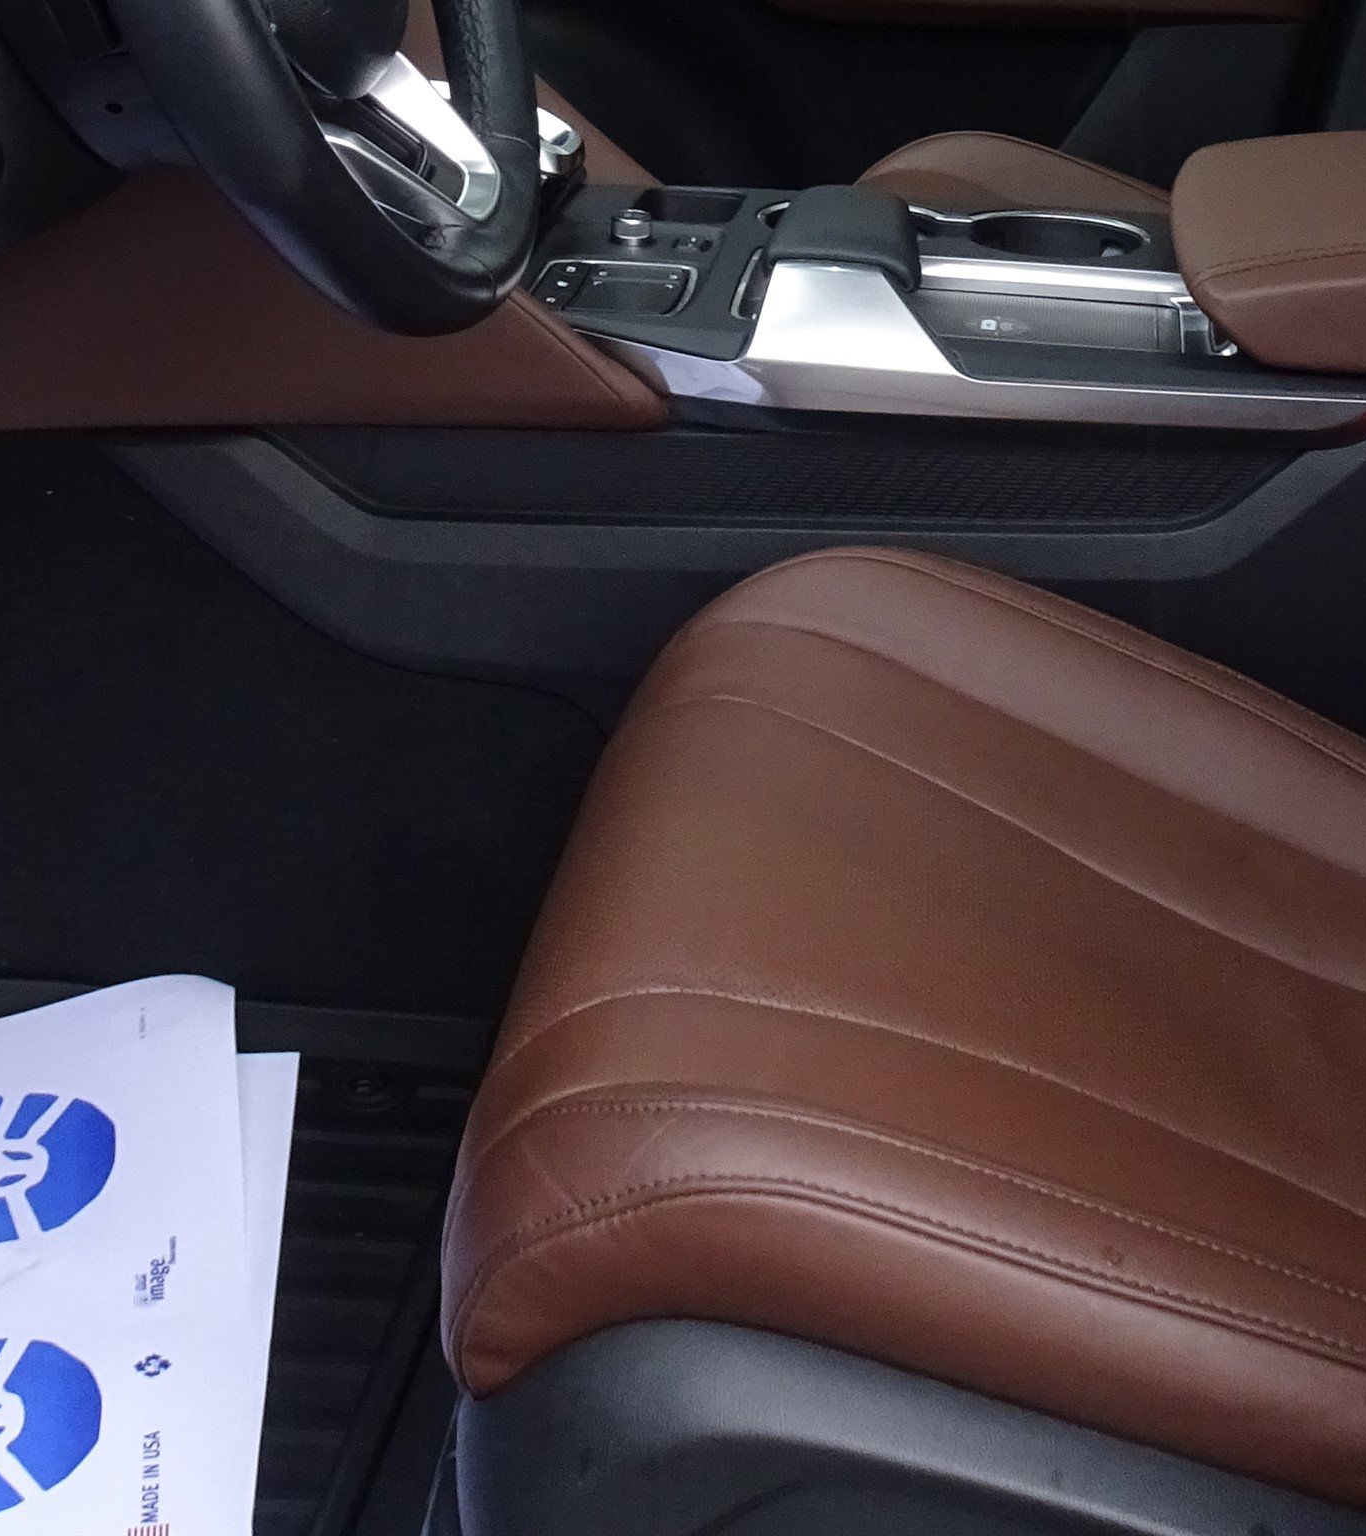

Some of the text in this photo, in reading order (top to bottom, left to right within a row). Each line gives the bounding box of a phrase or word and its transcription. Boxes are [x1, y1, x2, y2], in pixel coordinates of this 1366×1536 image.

[148, 1255, 169, 1301] image
[141, 1430, 160, 1523] MADE IN USA
